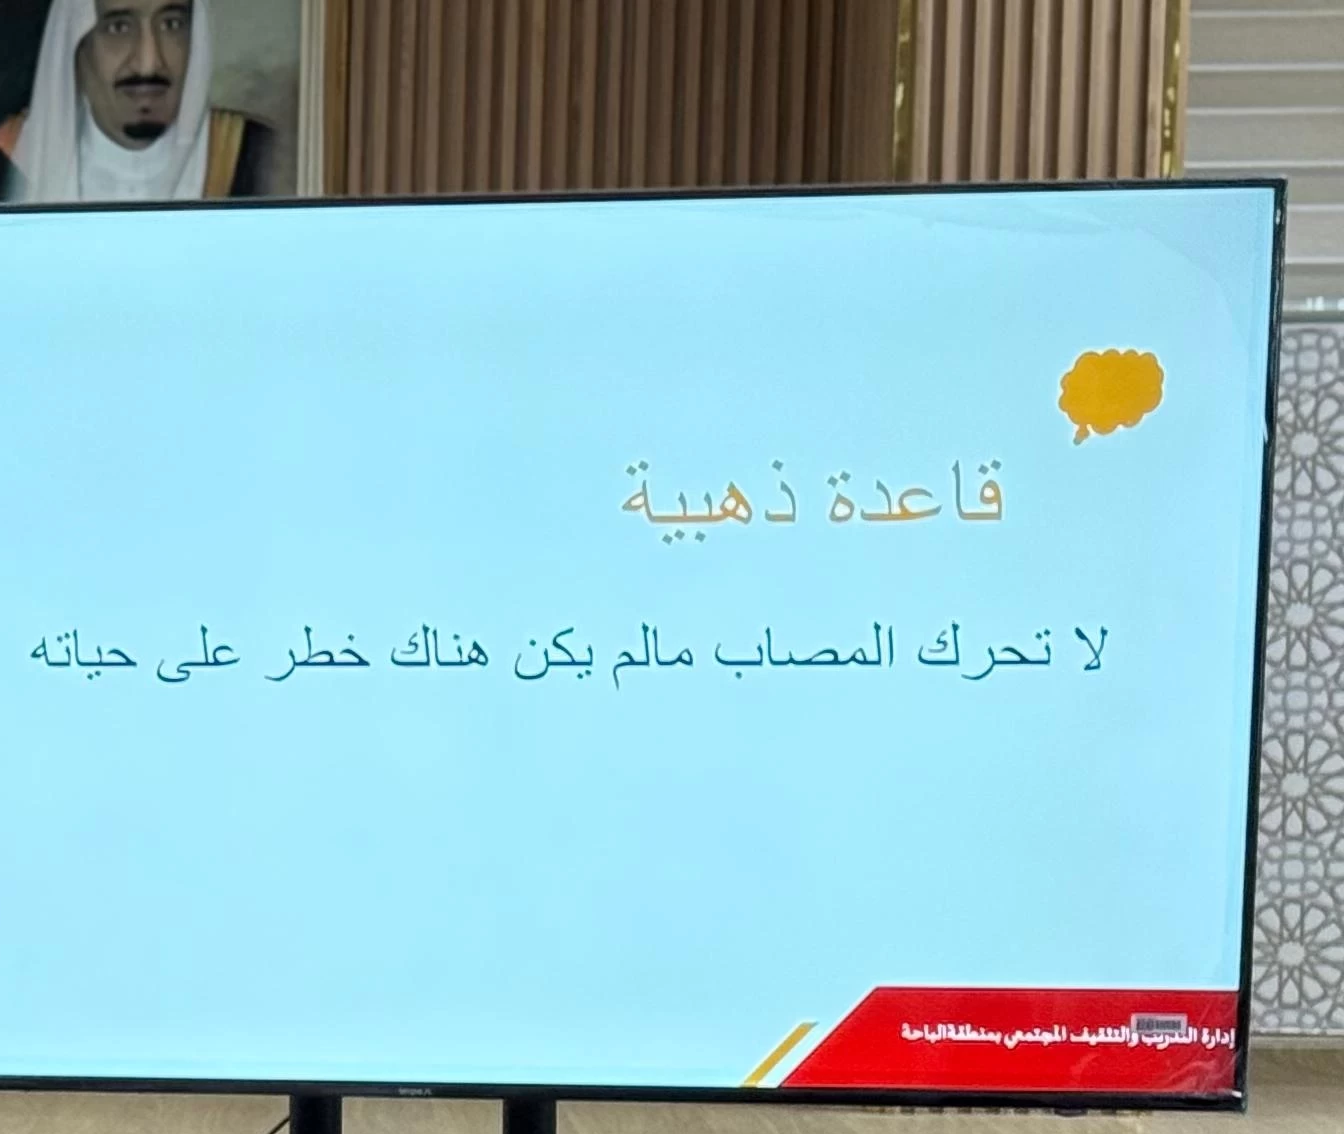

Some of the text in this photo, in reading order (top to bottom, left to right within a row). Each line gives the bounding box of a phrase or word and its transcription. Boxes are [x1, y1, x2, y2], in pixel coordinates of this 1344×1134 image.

[620, 458, 1004, 546] قاعدة ذهبية
[28, 620, 1110, 692] لا تحرك المصاب مالم يكن هناك خطر على حياته
[1003, 1023, 1067, 1050] المجتمعي
[1201, 1027, 1236, 1050] إدارة
